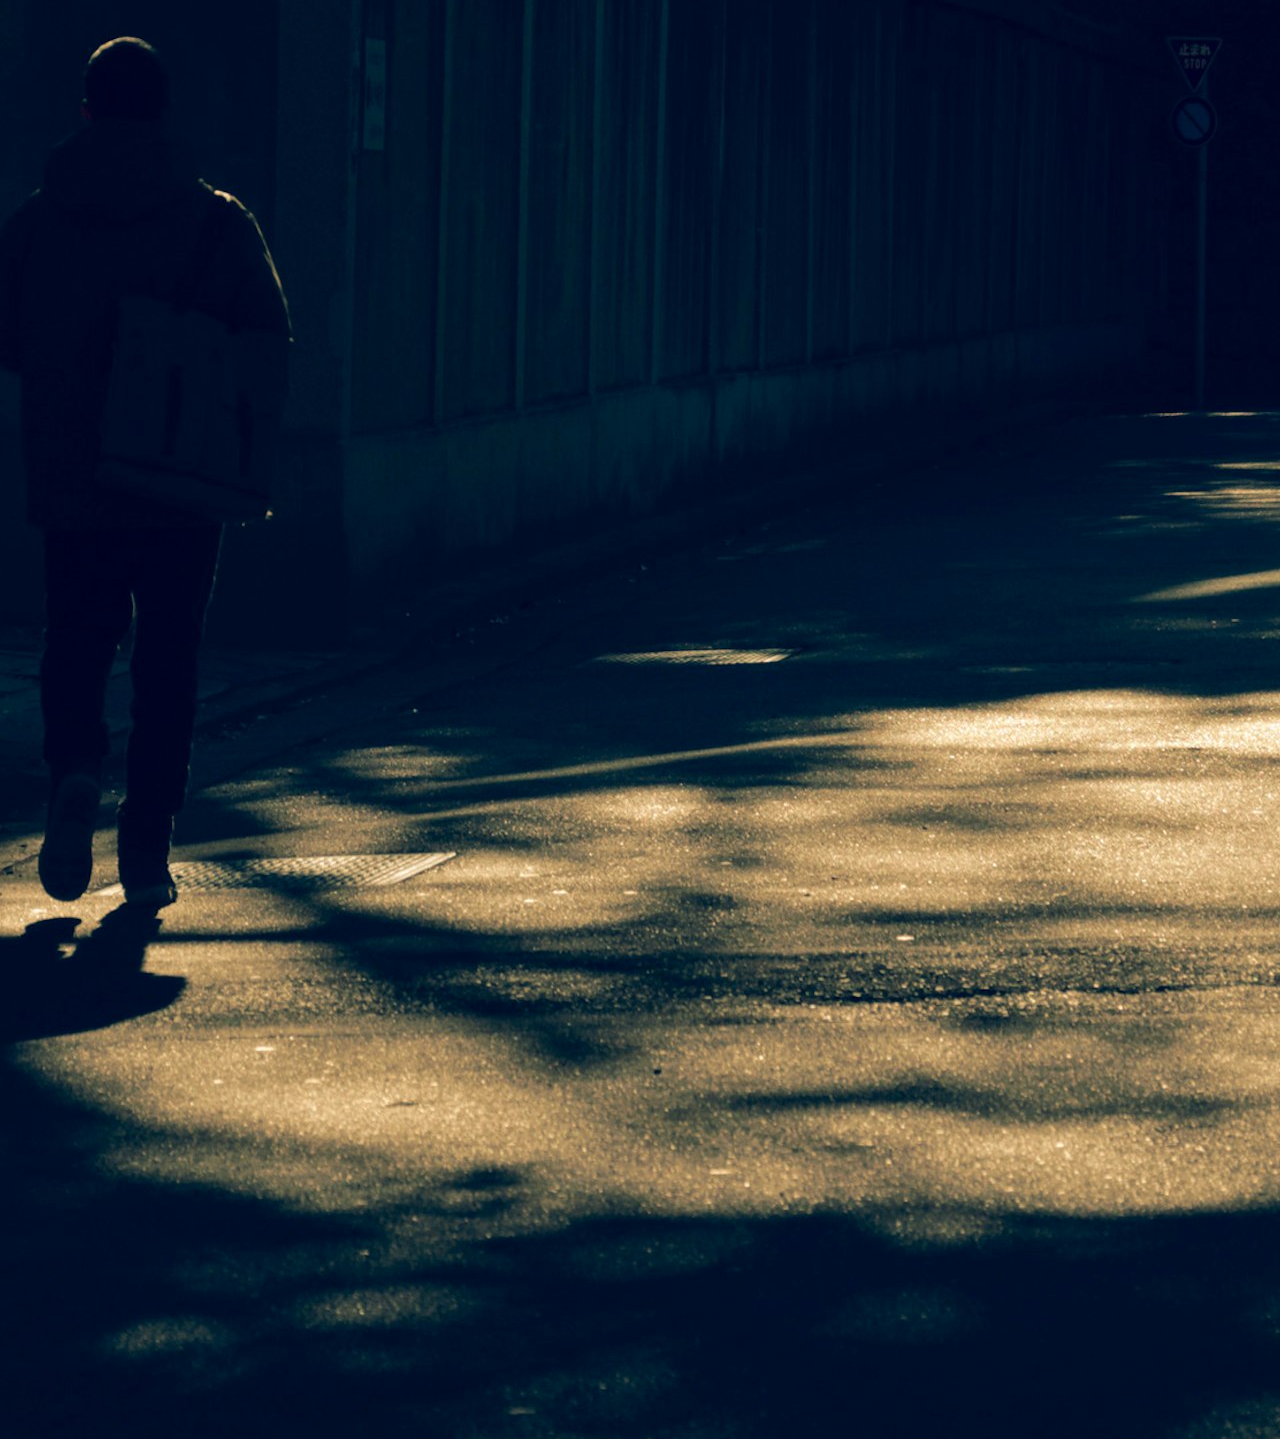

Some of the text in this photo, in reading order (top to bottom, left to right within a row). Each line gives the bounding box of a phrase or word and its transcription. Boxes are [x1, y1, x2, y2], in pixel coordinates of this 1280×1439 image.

[1179, 42, 1211, 56] 止まれ
[1184, 58, 1207, 70] STOP
